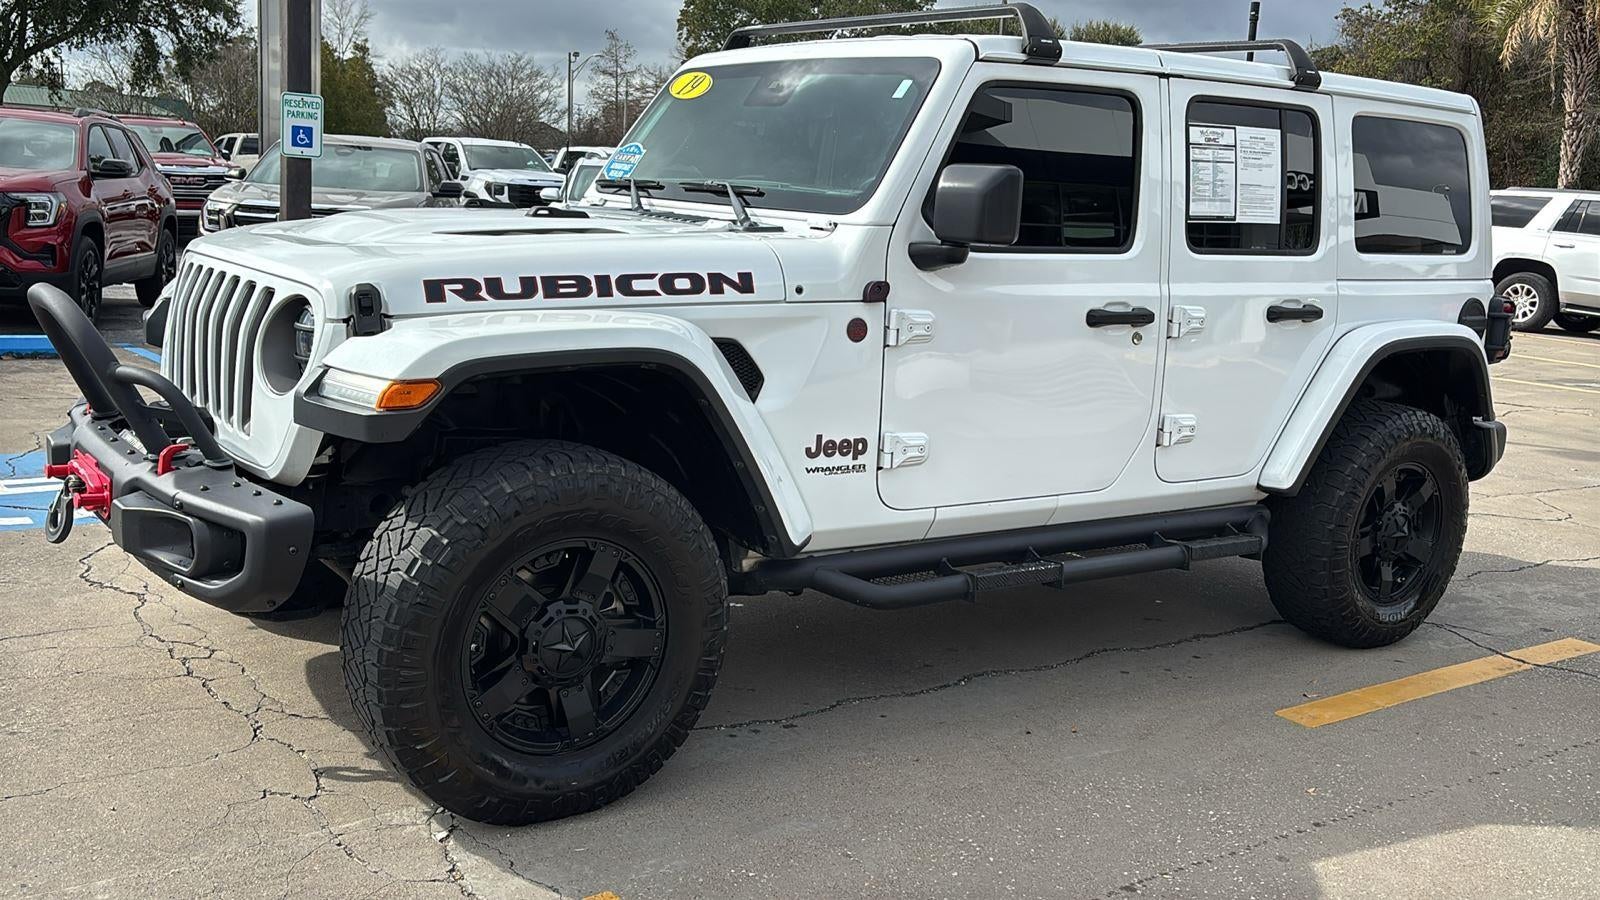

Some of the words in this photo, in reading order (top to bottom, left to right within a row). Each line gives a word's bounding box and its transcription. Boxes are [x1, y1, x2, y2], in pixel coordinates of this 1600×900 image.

[674, 74, 707, 95] 19
[284, 98, 320, 110] RESERVED
[286, 109, 319, 120] PARKING
[169, 175, 205, 184] GMC
[422, 271, 755, 303] RUBICON
[804, 433, 868, 461] Jeep
[805, 463, 867, 474] WRANGLER
